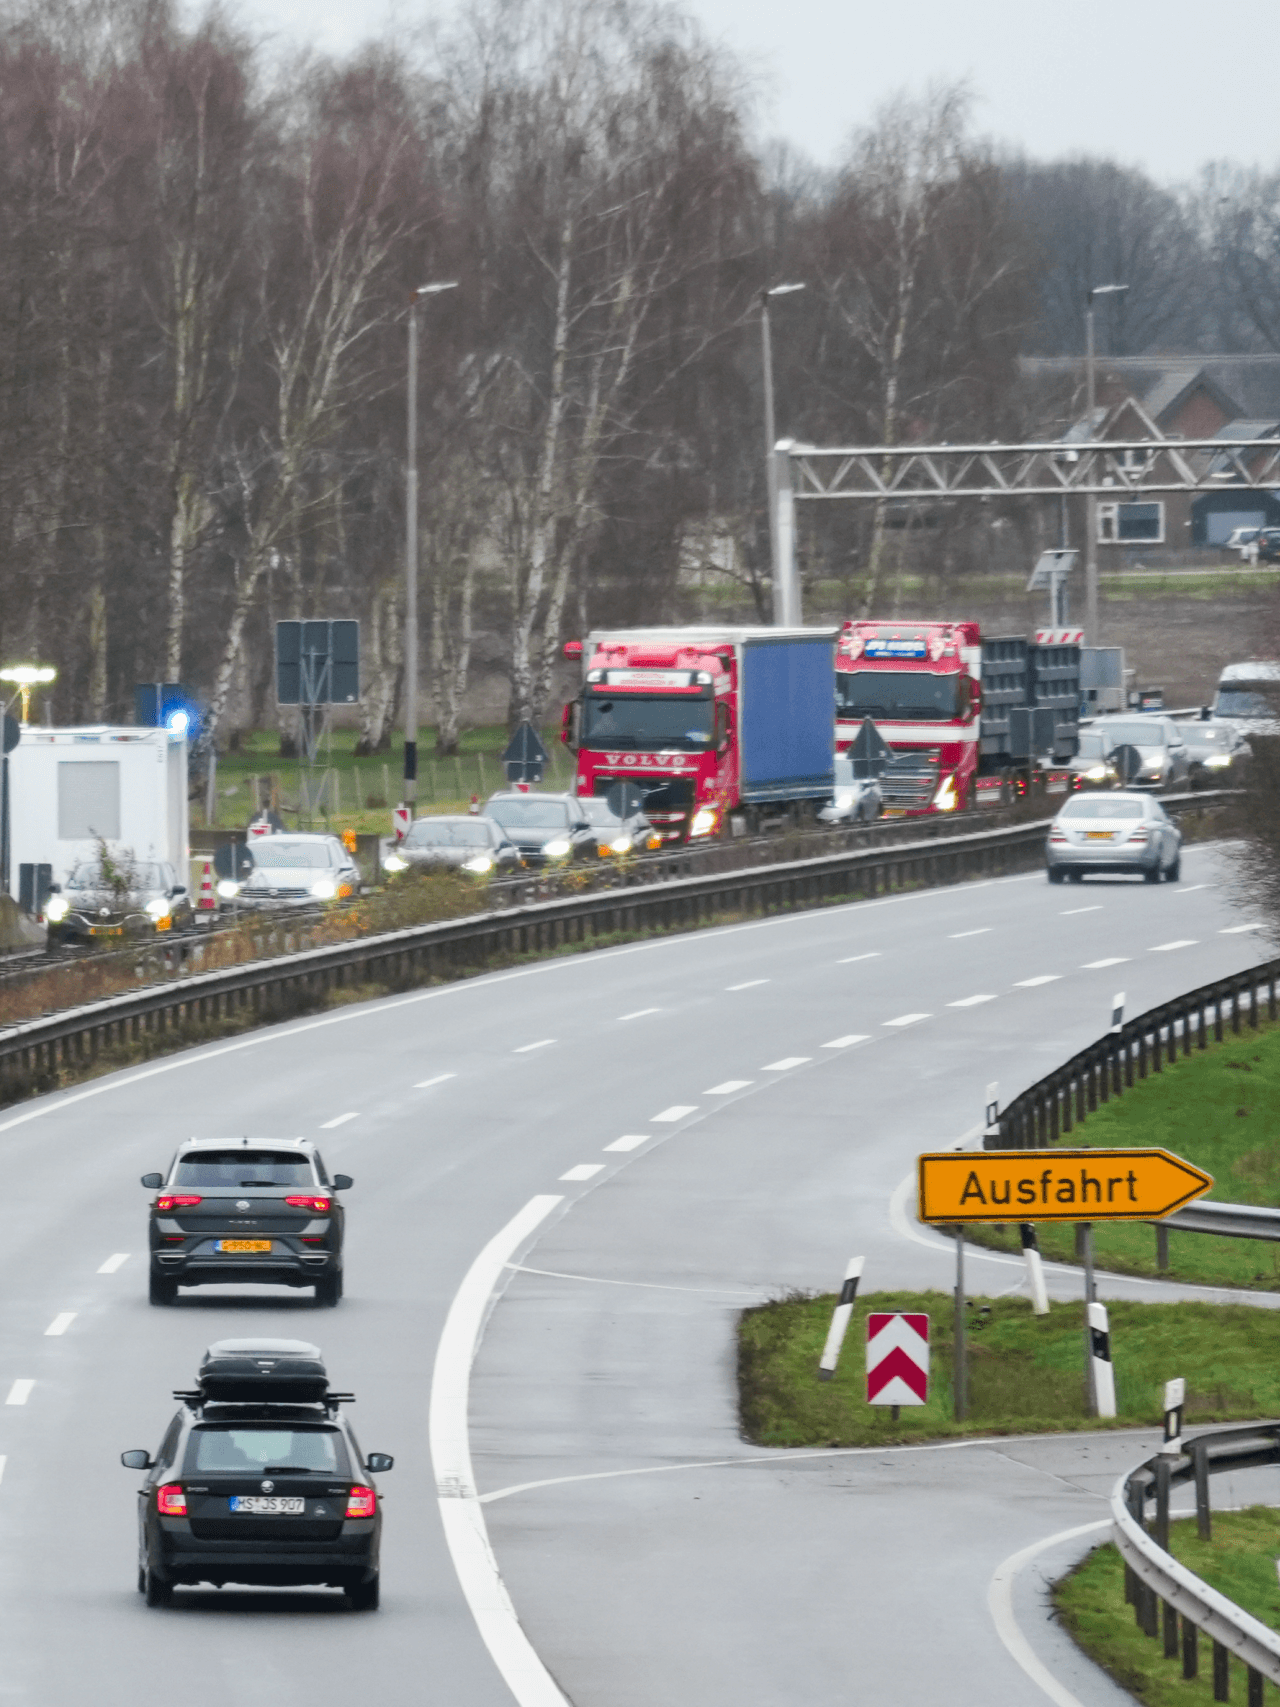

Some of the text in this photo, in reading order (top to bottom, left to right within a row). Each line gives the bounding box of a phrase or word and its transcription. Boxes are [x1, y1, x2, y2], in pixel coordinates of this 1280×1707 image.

[605, 754, 685, 766] VOLVO
[959, 1169, 1138, 1206] Ausfahrt
[237, 1498, 303, 1510] MS JS 907
